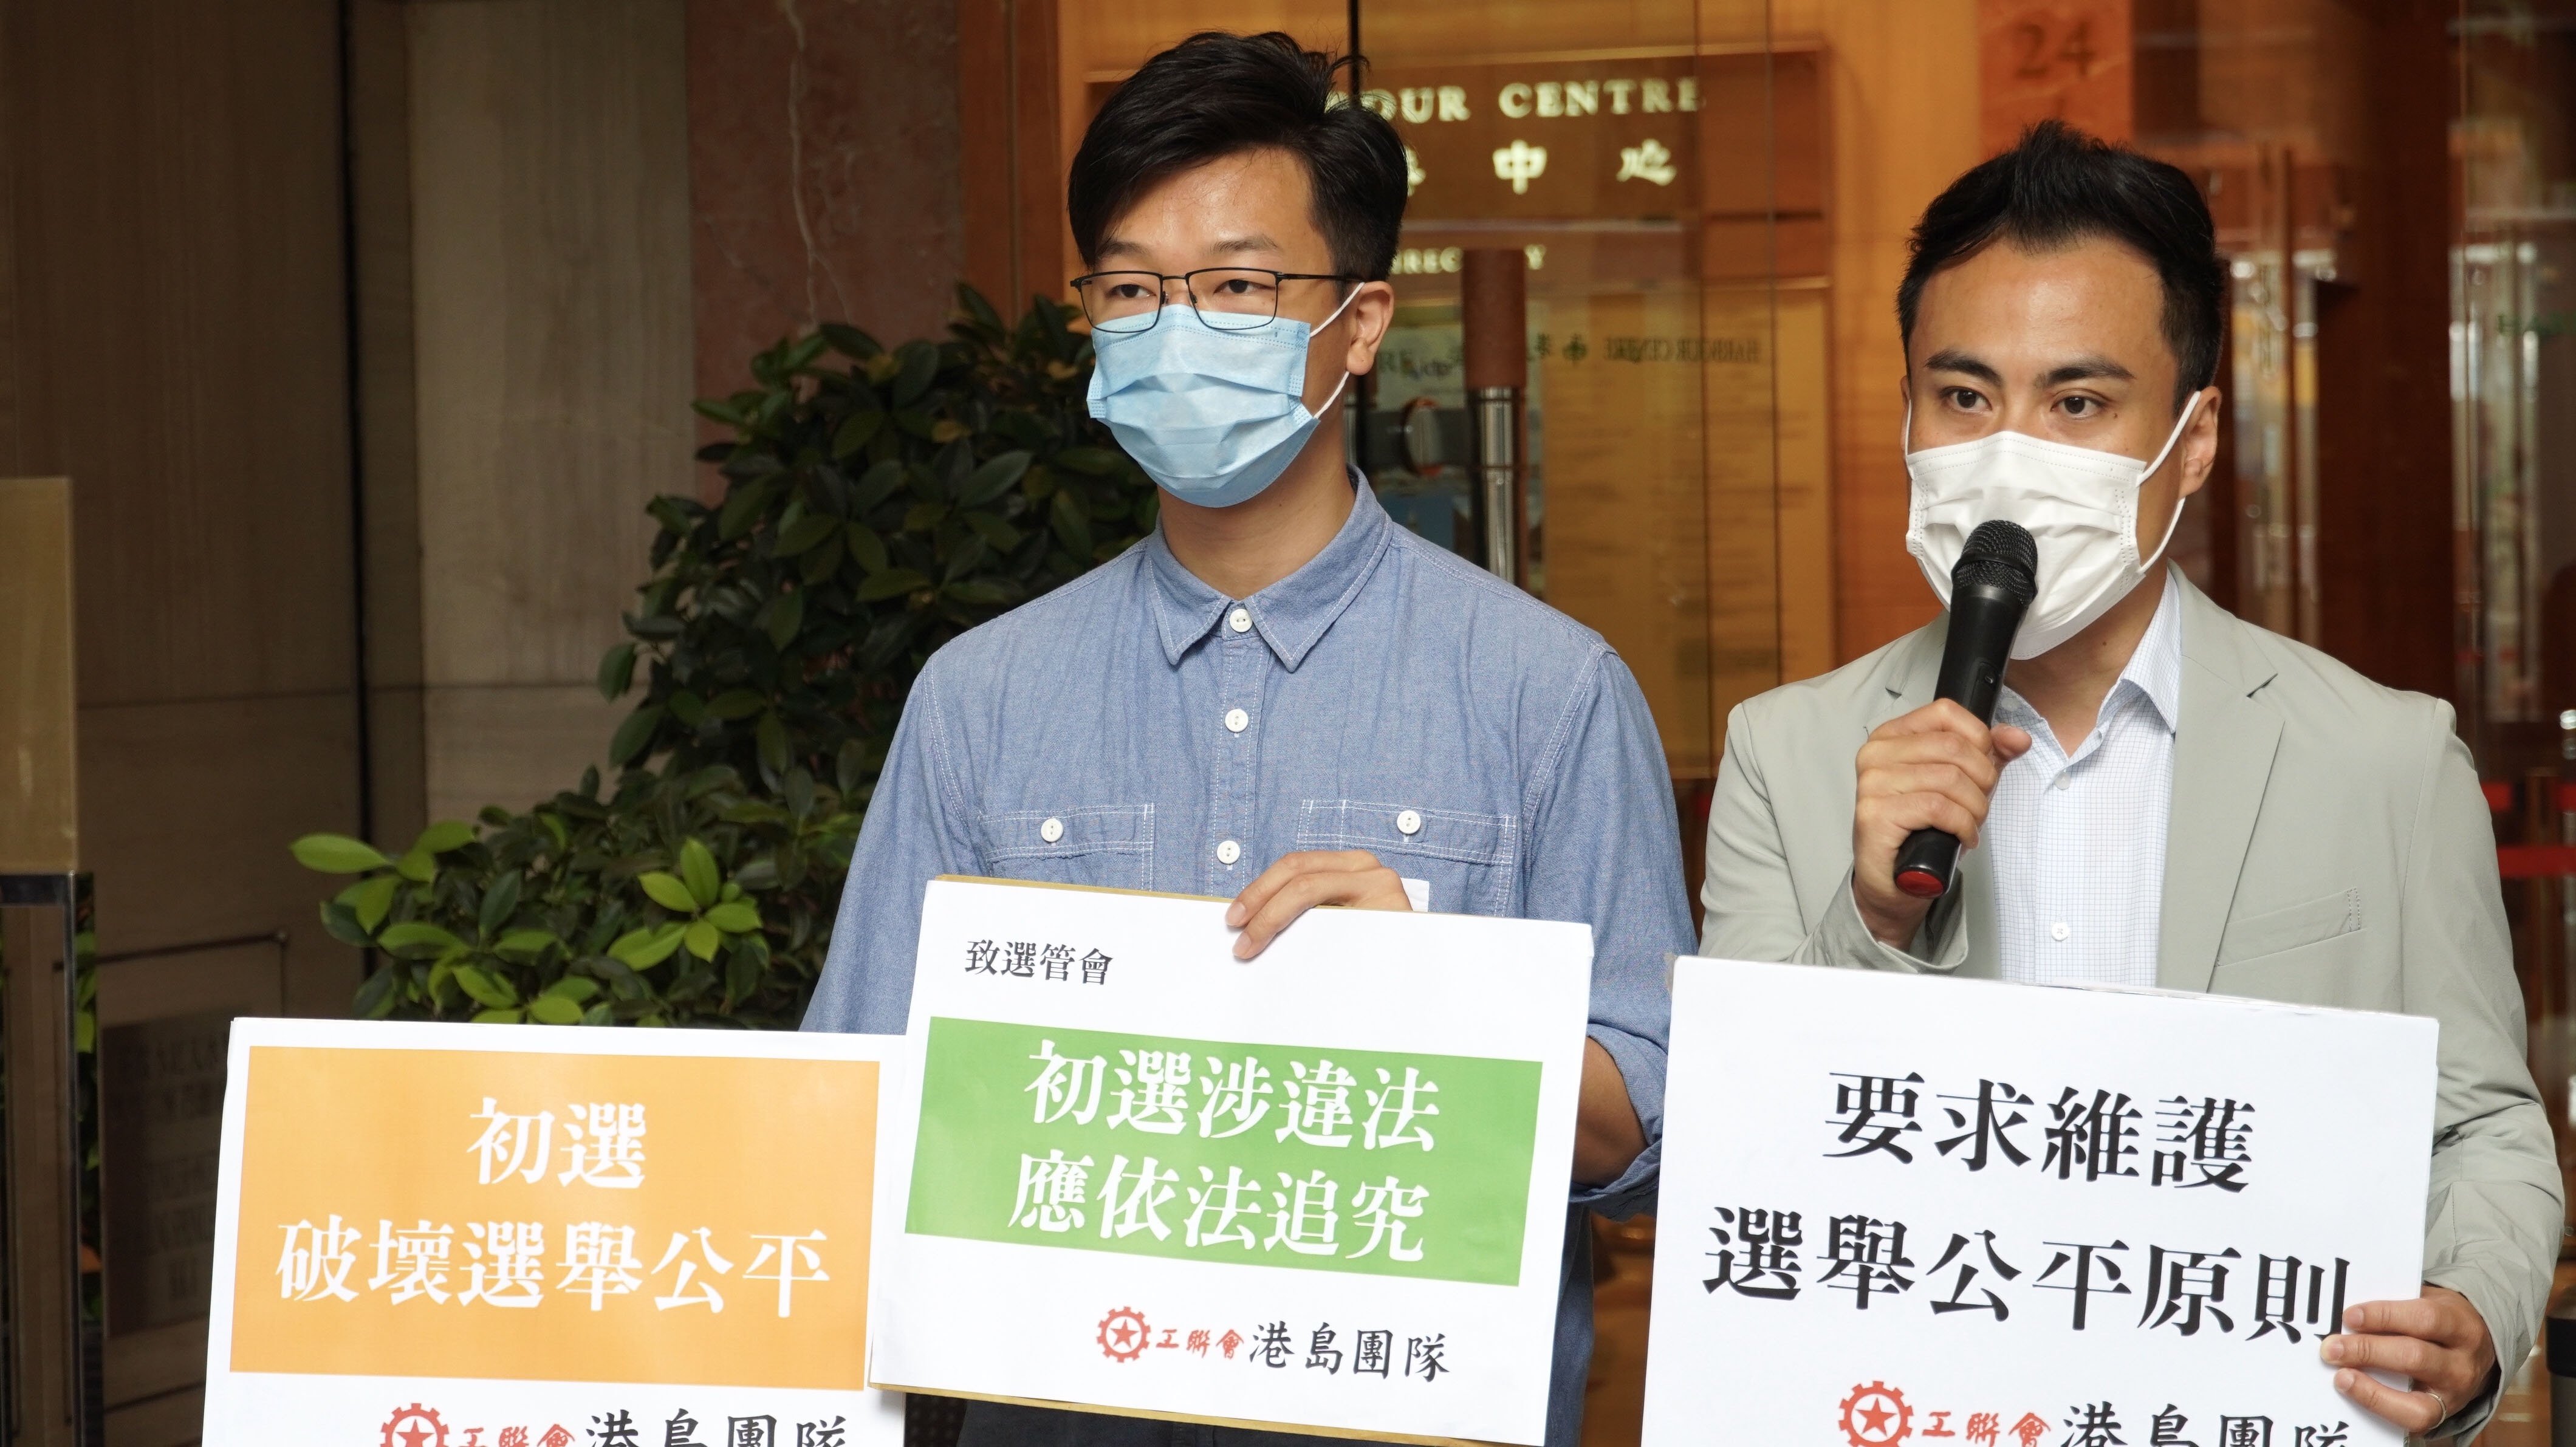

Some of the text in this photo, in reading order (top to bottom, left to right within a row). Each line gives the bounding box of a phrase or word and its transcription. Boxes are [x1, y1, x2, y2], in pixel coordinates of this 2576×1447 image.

[1498, 77, 1699, 118] CENTRE
[965, 939, 1113, 985] 致選管會
[467, 1096, 647, 1189] 初選
[1023, 1038, 1442, 1152] 初選涉違法
[1823, 1072, 2256, 1193] 要求維護
[1007, 1147, 1431, 1263] 應依法追究
[275, 1214, 831, 1318] 破壞選舉公平
[1702, 1206, 2351, 1344] 選舉公平原則
[1249, 1321, 1450, 1382] 港島團隊
